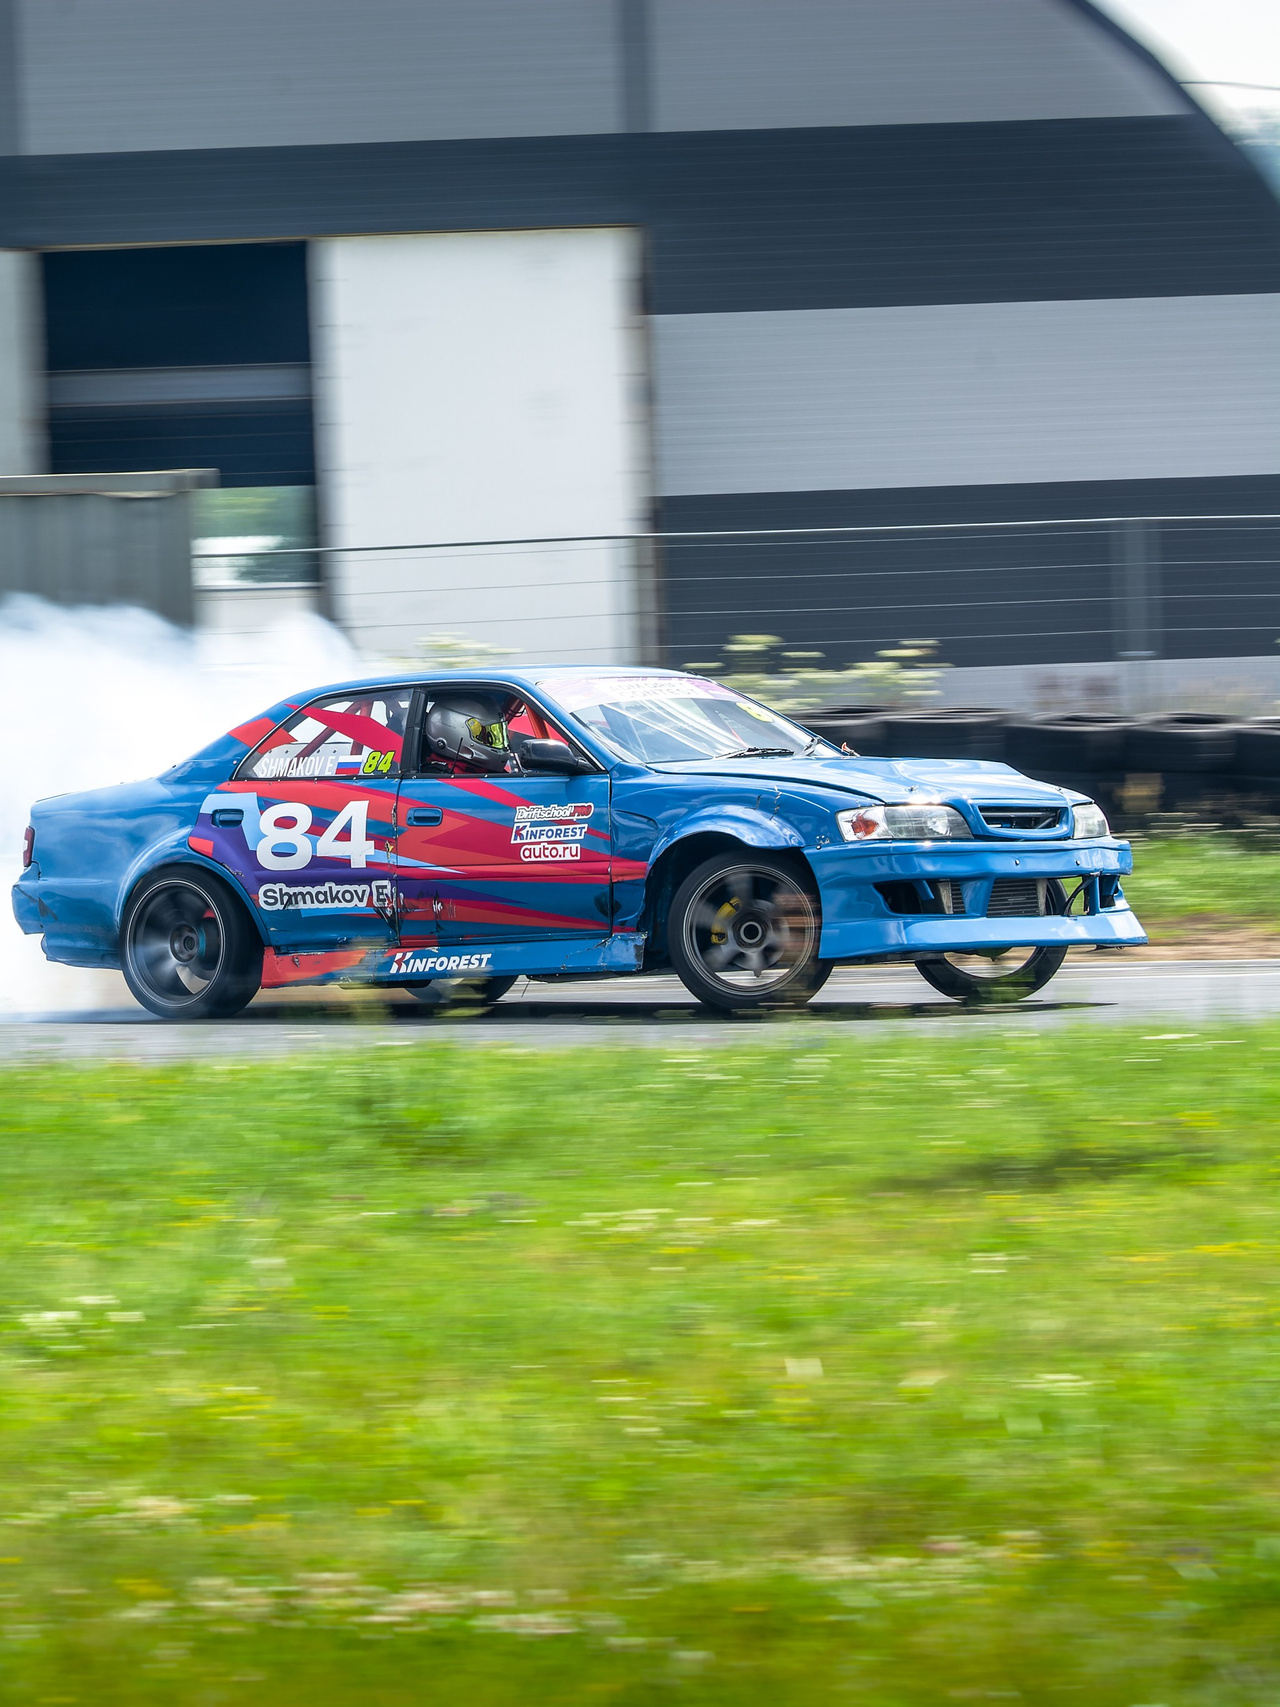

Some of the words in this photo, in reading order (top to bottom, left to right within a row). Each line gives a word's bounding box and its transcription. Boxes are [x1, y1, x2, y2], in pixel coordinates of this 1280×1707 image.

[260, 756, 324, 778] SHMAKOV
[325, 755, 336, 776] E
[363, 751, 395, 774] 84
[256, 800, 375, 871] 84
[513, 825, 586, 841] KINFOREST
[522, 845, 579, 859] auto.ru
[262, 886, 366, 906] Shmakov
[375, 885, 388, 903] E
[389, 951, 492, 974] KINFOREST
